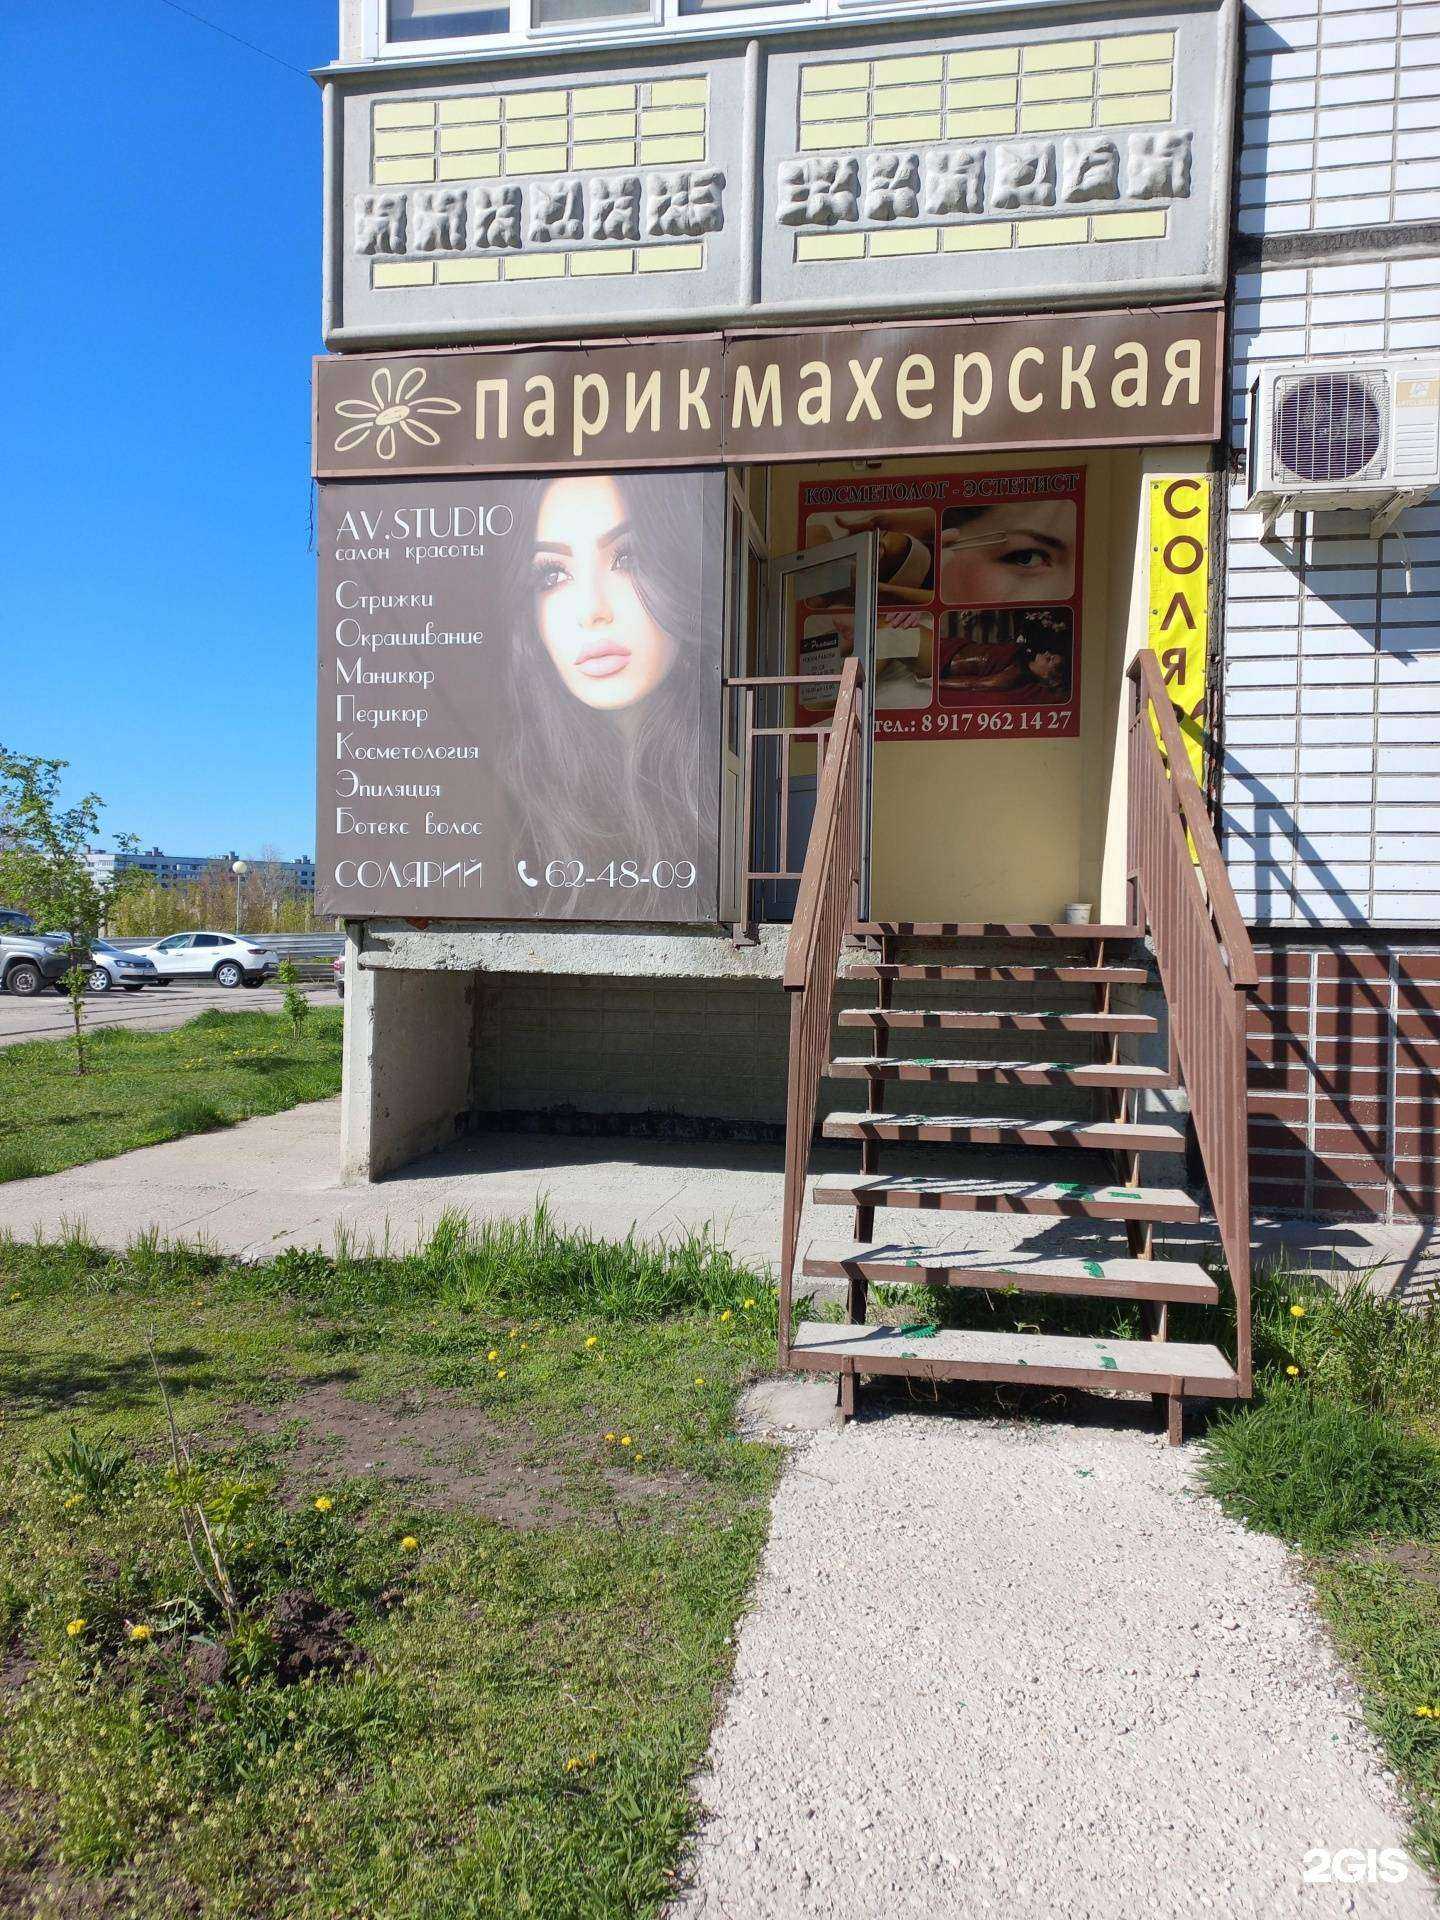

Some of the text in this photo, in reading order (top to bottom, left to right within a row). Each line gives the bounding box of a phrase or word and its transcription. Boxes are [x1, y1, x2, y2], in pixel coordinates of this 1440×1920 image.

[474, 338, 1202, 456] парикмахерская
[336, 504, 514, 542] AV.STUDIO
[335, 544, 484, 565] салон красоты
[335, 580, 433, 615] Стрижки
[335, 618, 484, 653] Окрашивание
[336, 656, 435, 690] Маникюр
[336, 694, 429, 729] Педикюр
[921, 714, 933, 732] 8
[937, 713, 973, 732] 917
[977, 712, 1014, 731] 962
[1019, 711, 1043, 730] 14
[1047, 711, 1072, 729] 27
[336, 732, 480, 760] Косметология
[335, 769, 441, 799] Эпиляция
[336, 807, 483, 835] Ботекс волос
[335, 858, 483, 889] СОЛЯРИЙ
[545, 859, 697, 889] 62-48-09
